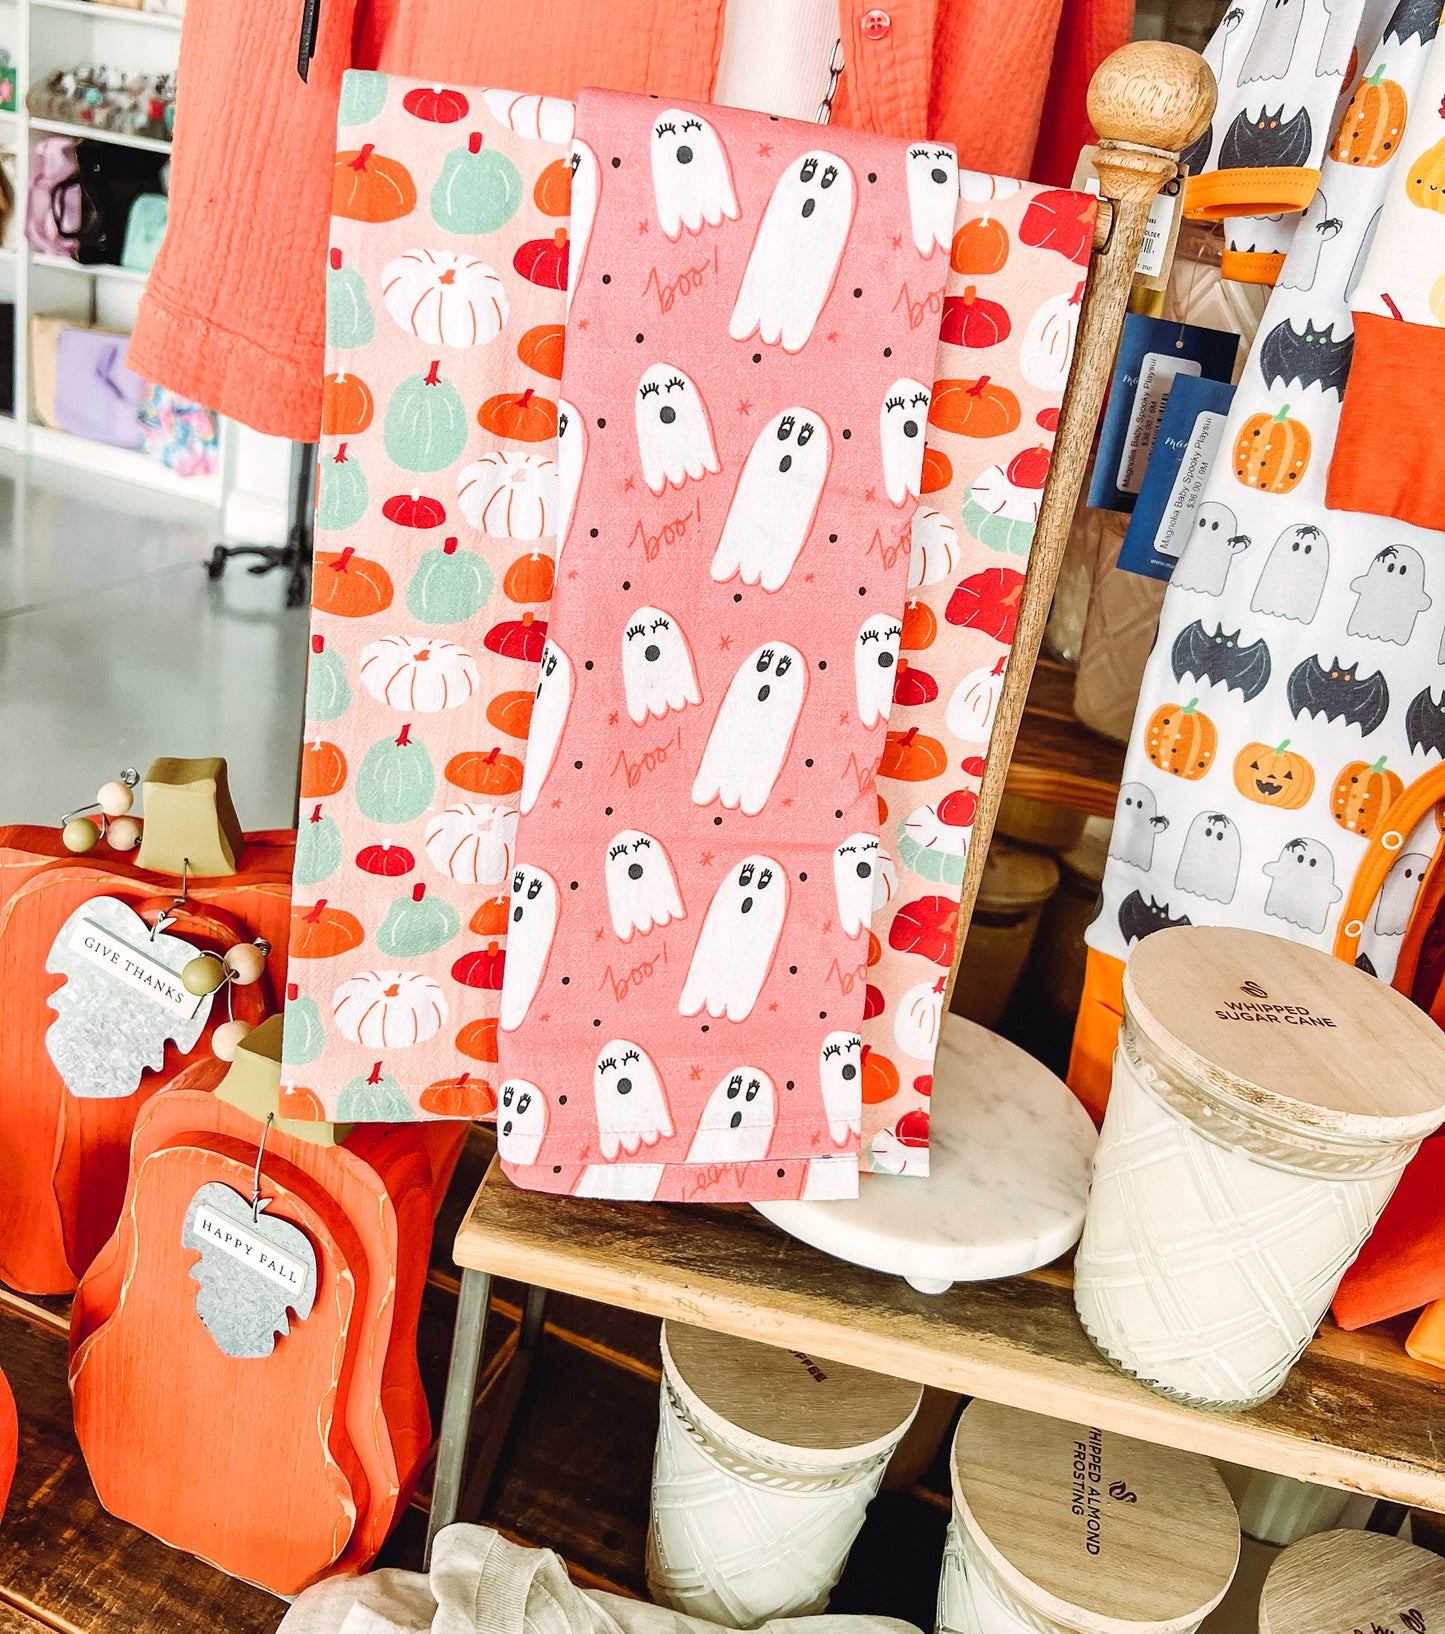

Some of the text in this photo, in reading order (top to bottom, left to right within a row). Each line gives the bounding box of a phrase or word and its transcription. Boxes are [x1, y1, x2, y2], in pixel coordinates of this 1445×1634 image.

[641, 245, 718, 315] boo!
[1130, 425, 1144, 447] Baby
[1136, 392, 1151, 424] Spooky
[1122, 447, 1137, 488] Magnolia
[1187, 480, 1202, 509] $36.00
[1200, 461, 1209, 475] 9M
[628, 496, 701, 563] boo!
[1160, 510, 1180, 549] Magnolia
[1174, 486, 1190, 508] Baby
[1182, 451, 1202, 484] Spooky
[610, 726, 681, 789] boo!
[84, 937, 184, 1004] GIVE THANKS
[599, 941, 668, 1002] boo!
[1215, 1010, 1337, 1028] SUGAR CANE
[1223, 1001, 1310, 1015] WHIPPED
[202, 1219, 297, 1284] HAPPY FALL
[789, 1350, 827, 1382] FFEE
[1071, 1441, 1086, 1515] FROSTING
[1086, 1486, 1101, 1555] ALMOND
